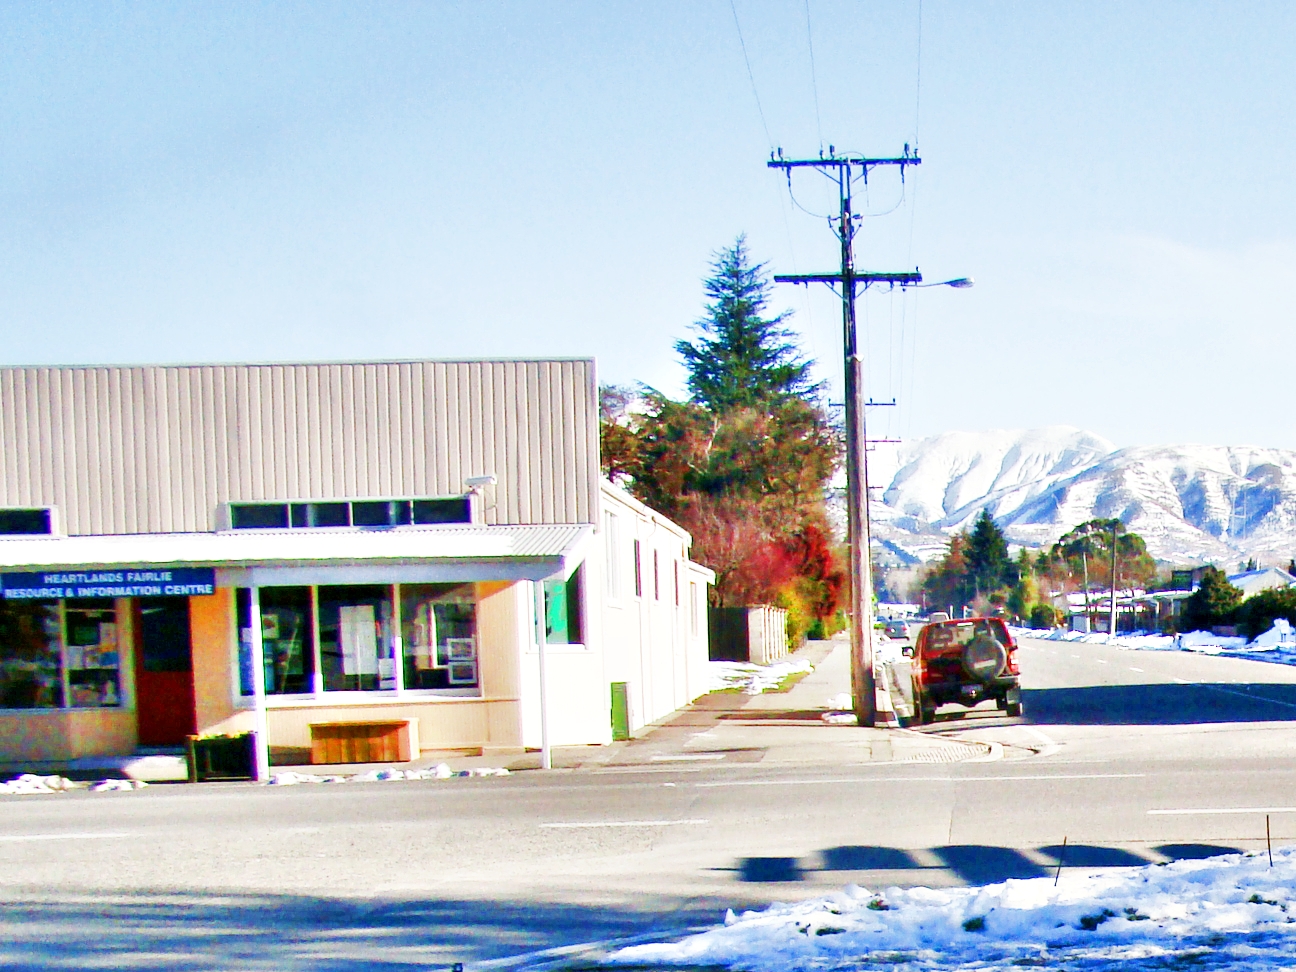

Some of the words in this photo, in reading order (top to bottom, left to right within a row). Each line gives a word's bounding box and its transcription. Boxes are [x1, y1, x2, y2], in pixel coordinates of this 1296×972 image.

[44, 573, 123, 584] HEARTLANDS
[127, 571, 172, 582] FAIRLIE
[4, 588, 64, 598] RESOURCE
[66, 588, 73, 597] &
[78, 586, 161, 597] INFORMATION
[165, 584, 213, 595] CENTRE
